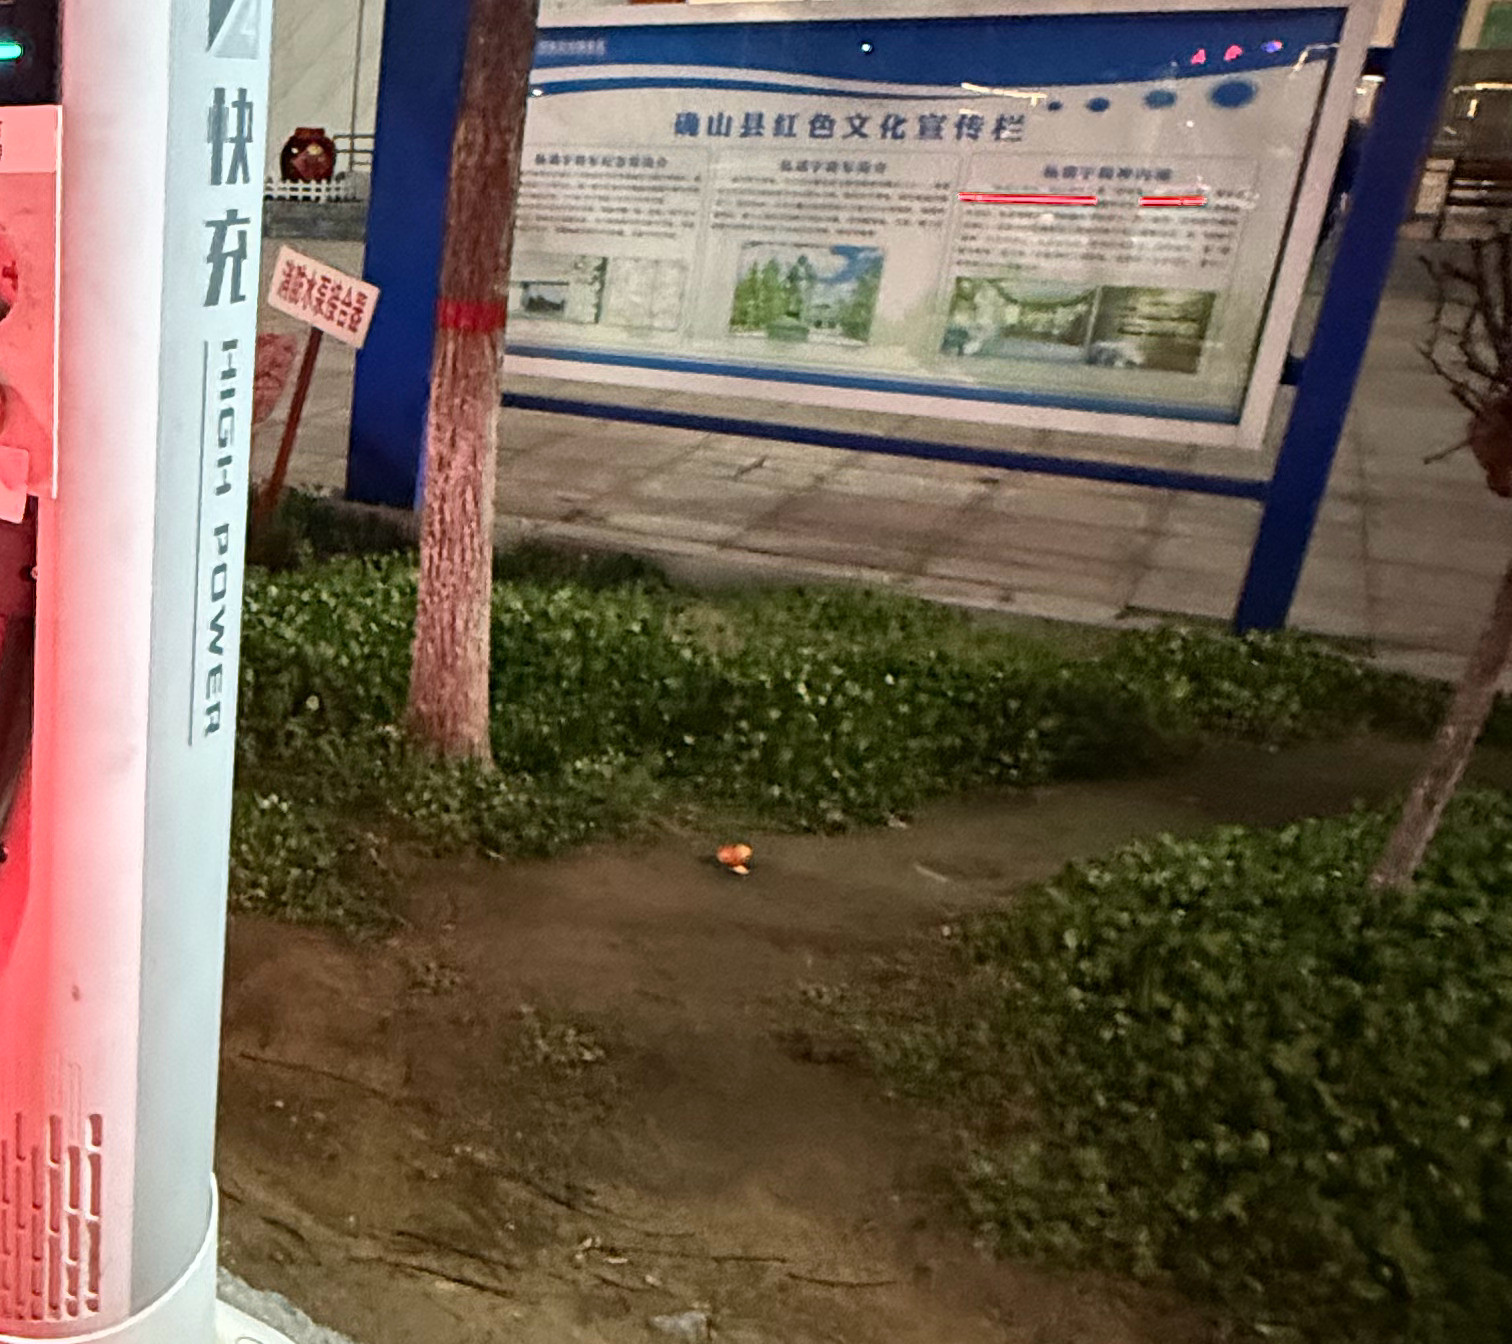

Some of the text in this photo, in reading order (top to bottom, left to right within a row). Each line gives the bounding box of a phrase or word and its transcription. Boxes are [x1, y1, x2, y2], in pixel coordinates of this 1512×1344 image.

[203, 87, 254, 307] 快充
[674, 111, 1025, 142] 确山县红色文化宣传栏
[203, 338, 239, 738] HIGH POWER
